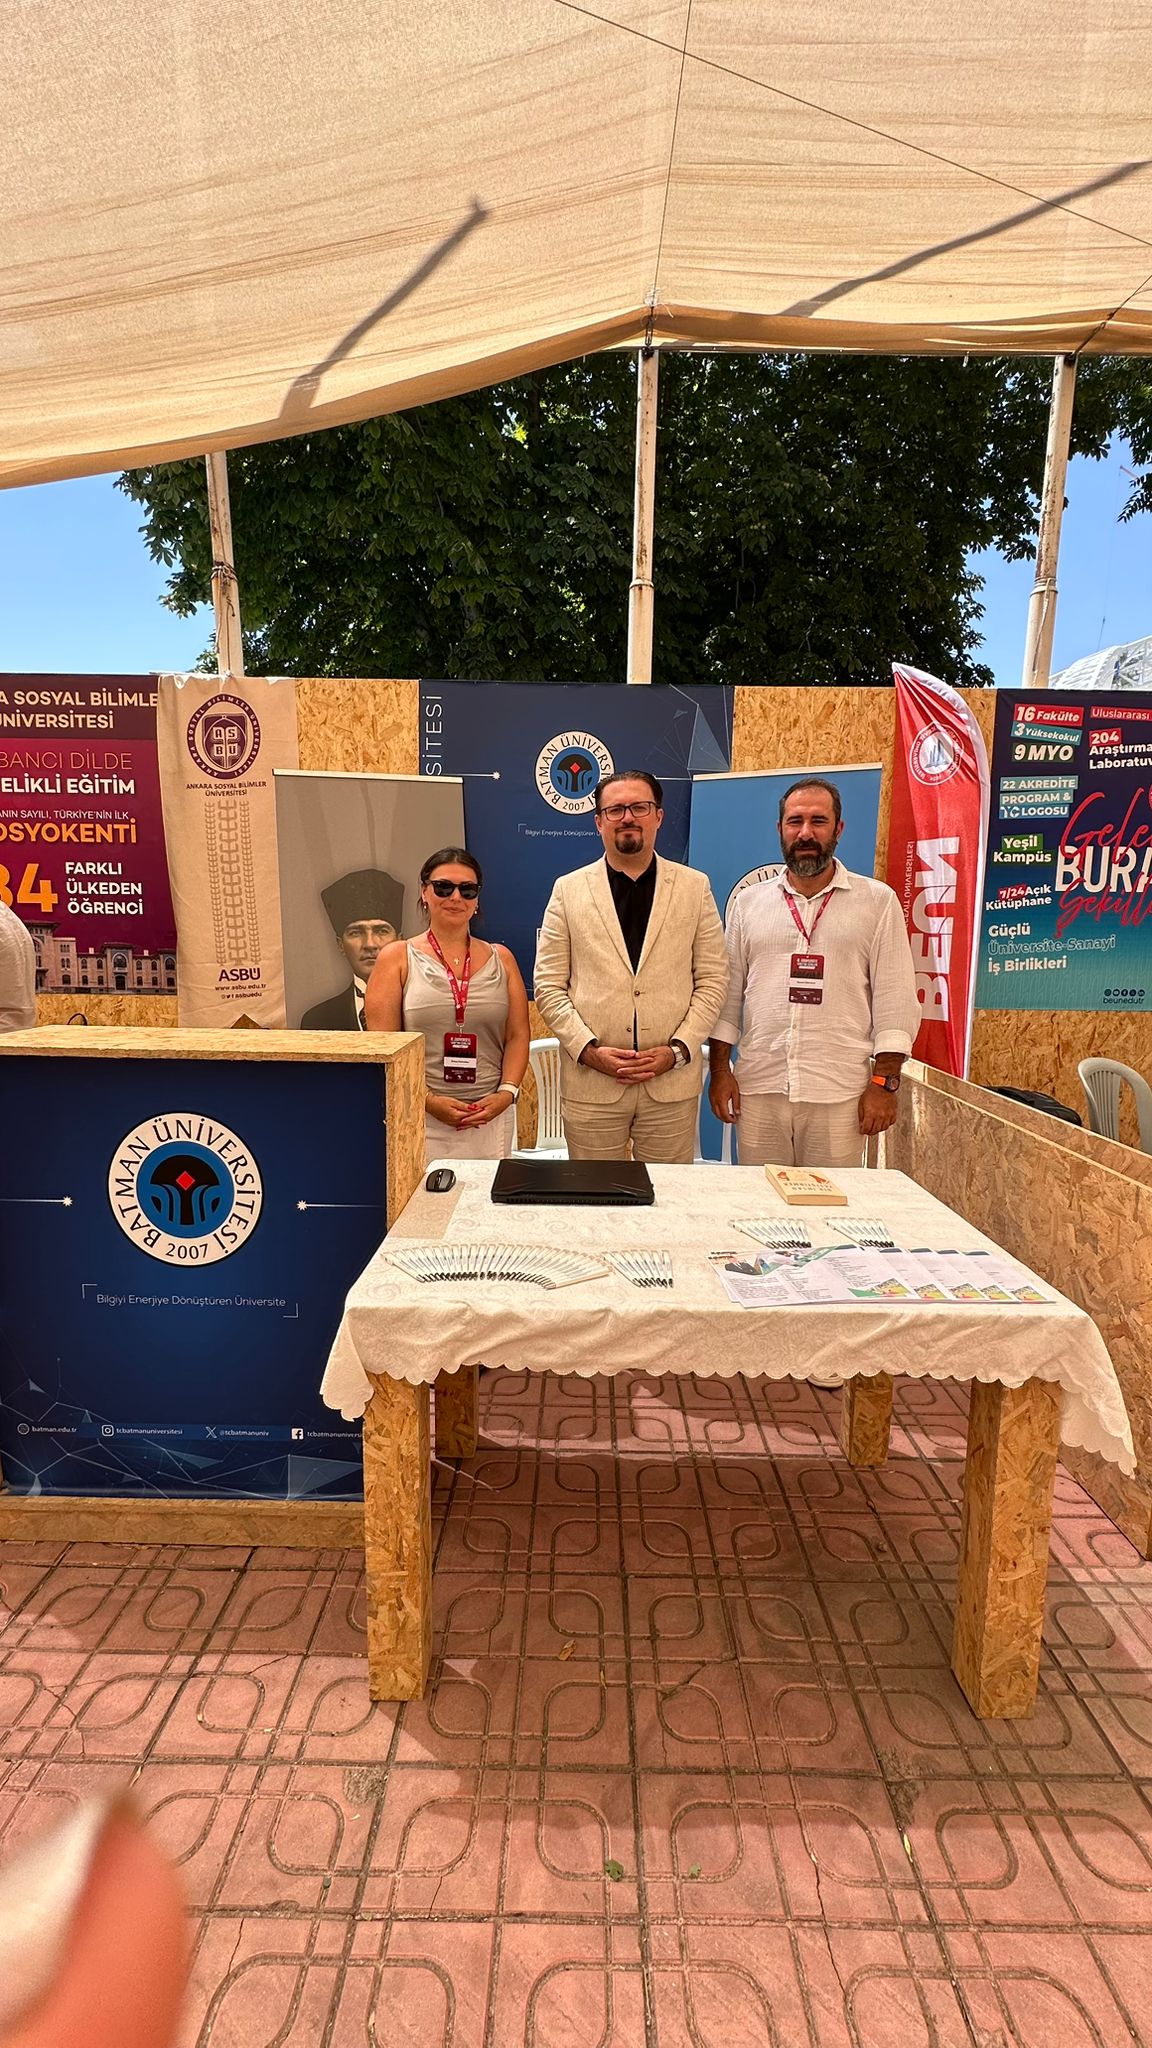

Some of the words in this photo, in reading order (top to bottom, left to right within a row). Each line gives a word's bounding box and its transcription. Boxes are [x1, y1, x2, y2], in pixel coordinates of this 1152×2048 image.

[14, 691, 86, 706] SOSYAL
[0, 709, 114, 728] NİVERSİTESİ
[1016, 706, 1036, 722] 16
[1036, 710, 1080, 722] Fakülte
[1092, 708, 1150, 720] Uluslararası
[422, 695, 442, 775] SİTESİ
[1014, 722, 1026, 737] 3
[1025, 727, 1080, 742] Yüksekokul
[1091, 731, 1119, 745] 204
[1014, 744, 1026, 761] 9
[1027, 744, 1074, 761] MYO
[1089, 743, 1152, 757] Araştırma
[71, 749, 133, 770] DİLDE
[539, 744, 561, 804] BATMAN
[1, 773, 61, 793] ELİKLİ
[67, 774, 135, 794] EĞİTİM
[1002, 780, 1016, 789] 22
[1018, 776, 1076, 789] AKREDİTE
[1002, 793, 1060, 804] PROGRAM
[1062, 792, 1071, 801] &
[562, 801, 585, 811] 2007
[1021, 806, 1068, 816] LOGOSU
[115, 809, 129, 820] İLK
[1060, 787, 1152, 871] Gele
[1004, 835, 1038, 849] Yeşil
[993, 851, 1052, 865] Kampüs
[65, 862, 122, 875] FARKLI
[66, 878, 142, 895] ÜLKEDEN
[1000, 886, 1025, 899] 7/24
[1024, 884, 1052, 898] Açık
[67, 898, 143, 915] ÖĞRENCİ
[985, 896, 1052, 911] Kütüphane
[988, 922, 1031, 940] Güçlü
[988, 934, 1116, 955] Üniversite-Sanayi
[988, 957, 1001, 976] İş
[1004, 955, 1067, 972] Birlikleri
[115, 1136, 162, 1248] BATMAN
[152, 1117, 260, 1254] ÜNİVERSİTESİ
[166, 1242, 209, 1259] 2007
[96, 1294, 126, 1307] Bilgiyi
[128, 1294, 169, 1307] Enerjiye
[171, 1295, 232, 1307] Dönüştüren
[234, 1294, 286, 1307] Üniversite
[116, 1427, 183, 1435] tcbatmanuniversitesi
